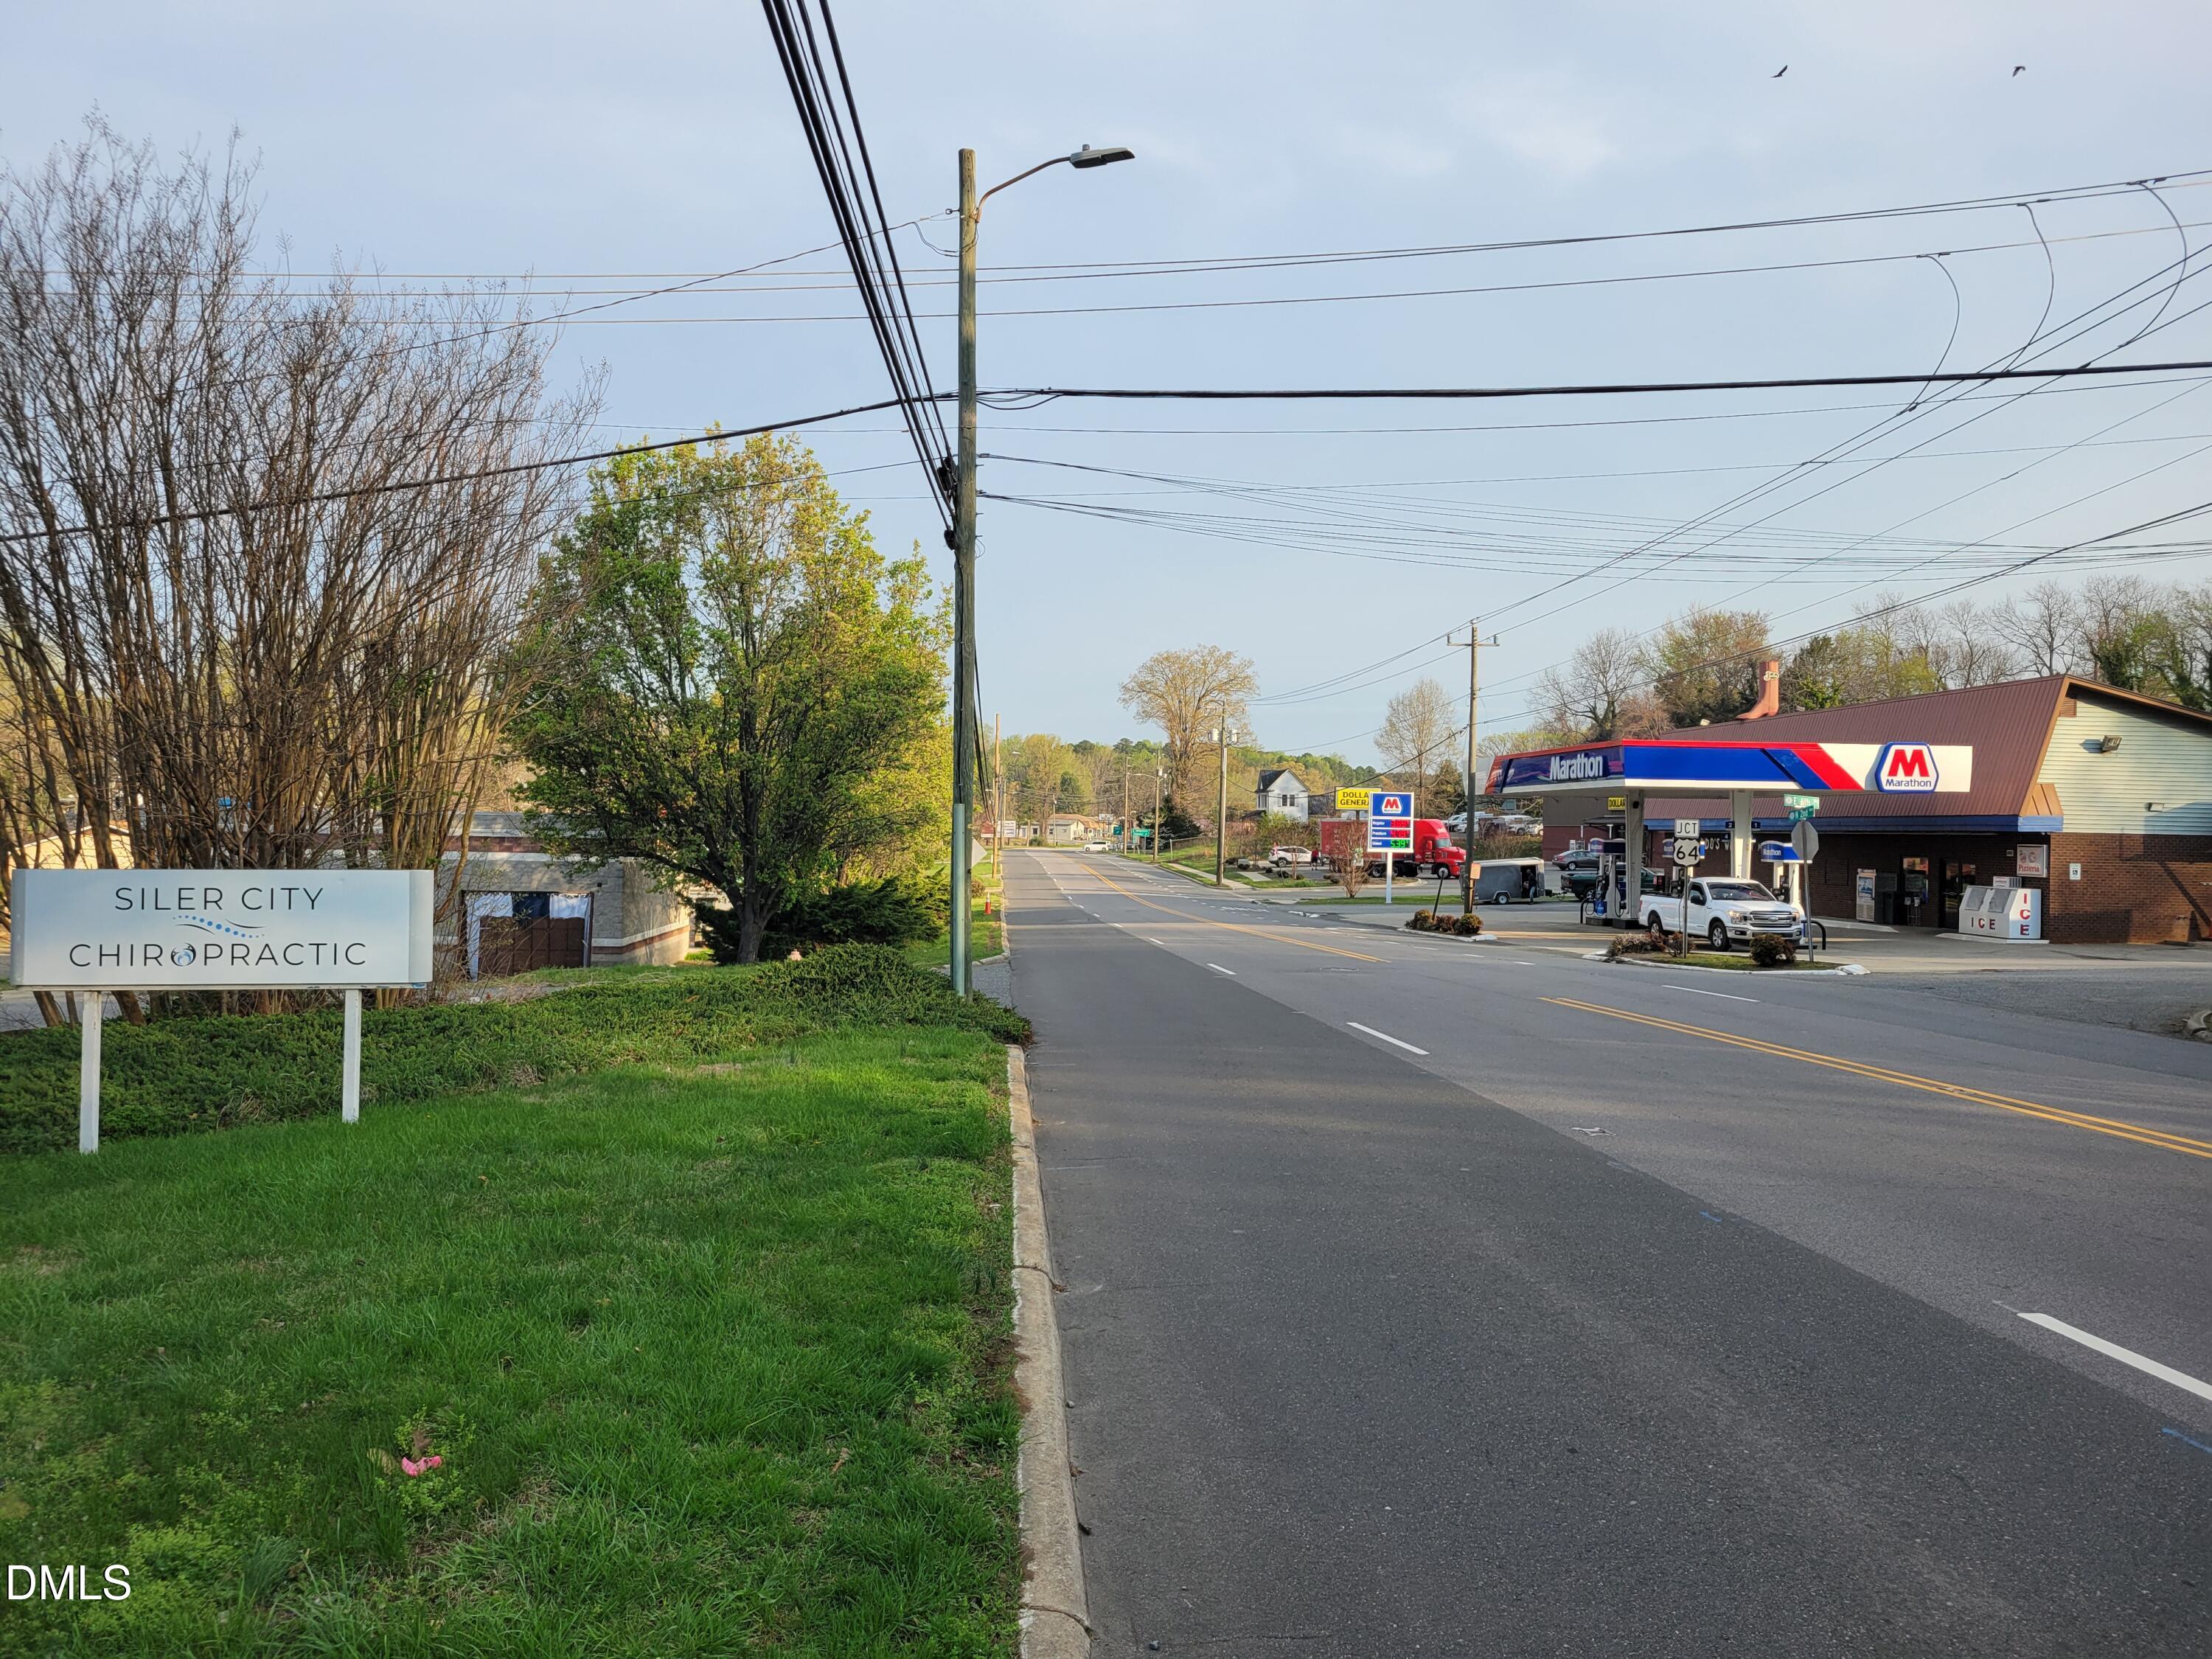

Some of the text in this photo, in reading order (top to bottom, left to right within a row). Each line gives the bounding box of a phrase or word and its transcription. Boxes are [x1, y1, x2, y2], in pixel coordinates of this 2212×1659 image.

[1550, 752, 1603, 781] Marathon
[1888, 749, 1930, 777] M
[1885, 778, 1932, 787] Marathon
[1677, 822, 1697, 834] JCT
[1676, 846, 1698, 860] 64
[2018, 864, 2040, 872] Pizzeria
[115, 887, 324, 911] SILER CITY
[1971, 917, 1995, 930] ICE
[2020, 893, 2031, 936] ICE
[69, 942, 367, 967] CHIROPRACTIC
